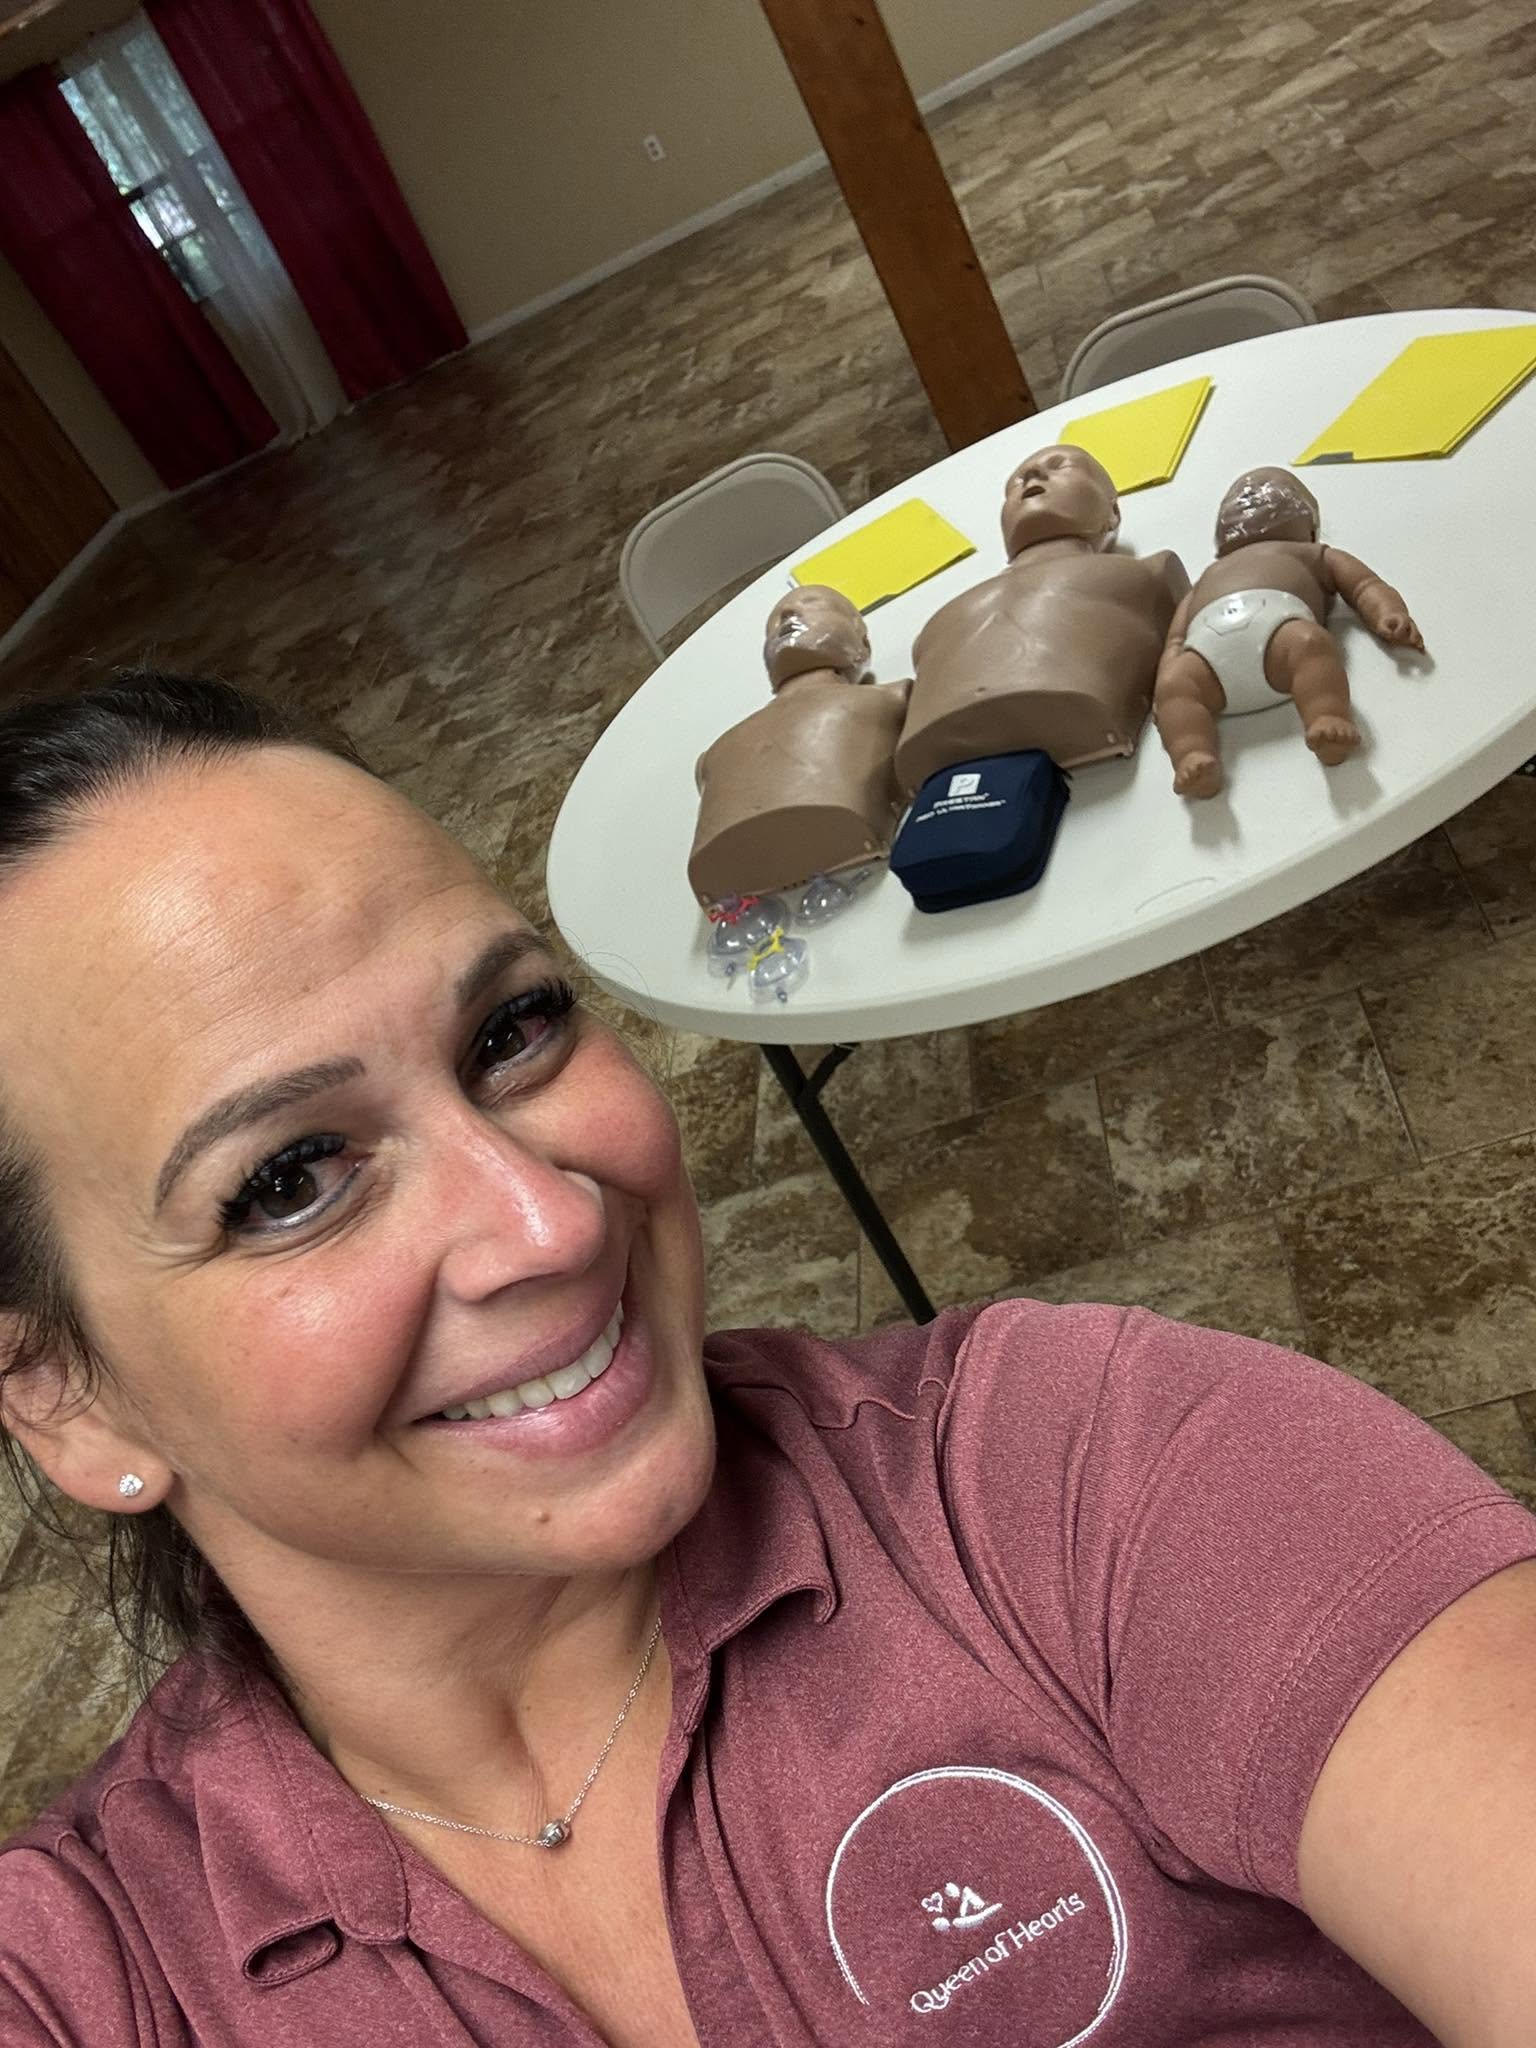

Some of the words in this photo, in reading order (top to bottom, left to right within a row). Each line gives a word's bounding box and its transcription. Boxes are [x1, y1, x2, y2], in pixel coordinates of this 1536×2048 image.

[910, 1956, 989, 2013] Queen
[985, 1932, 1010, 1963] of
[1007, 1893, 1086, 1950] Hearts
